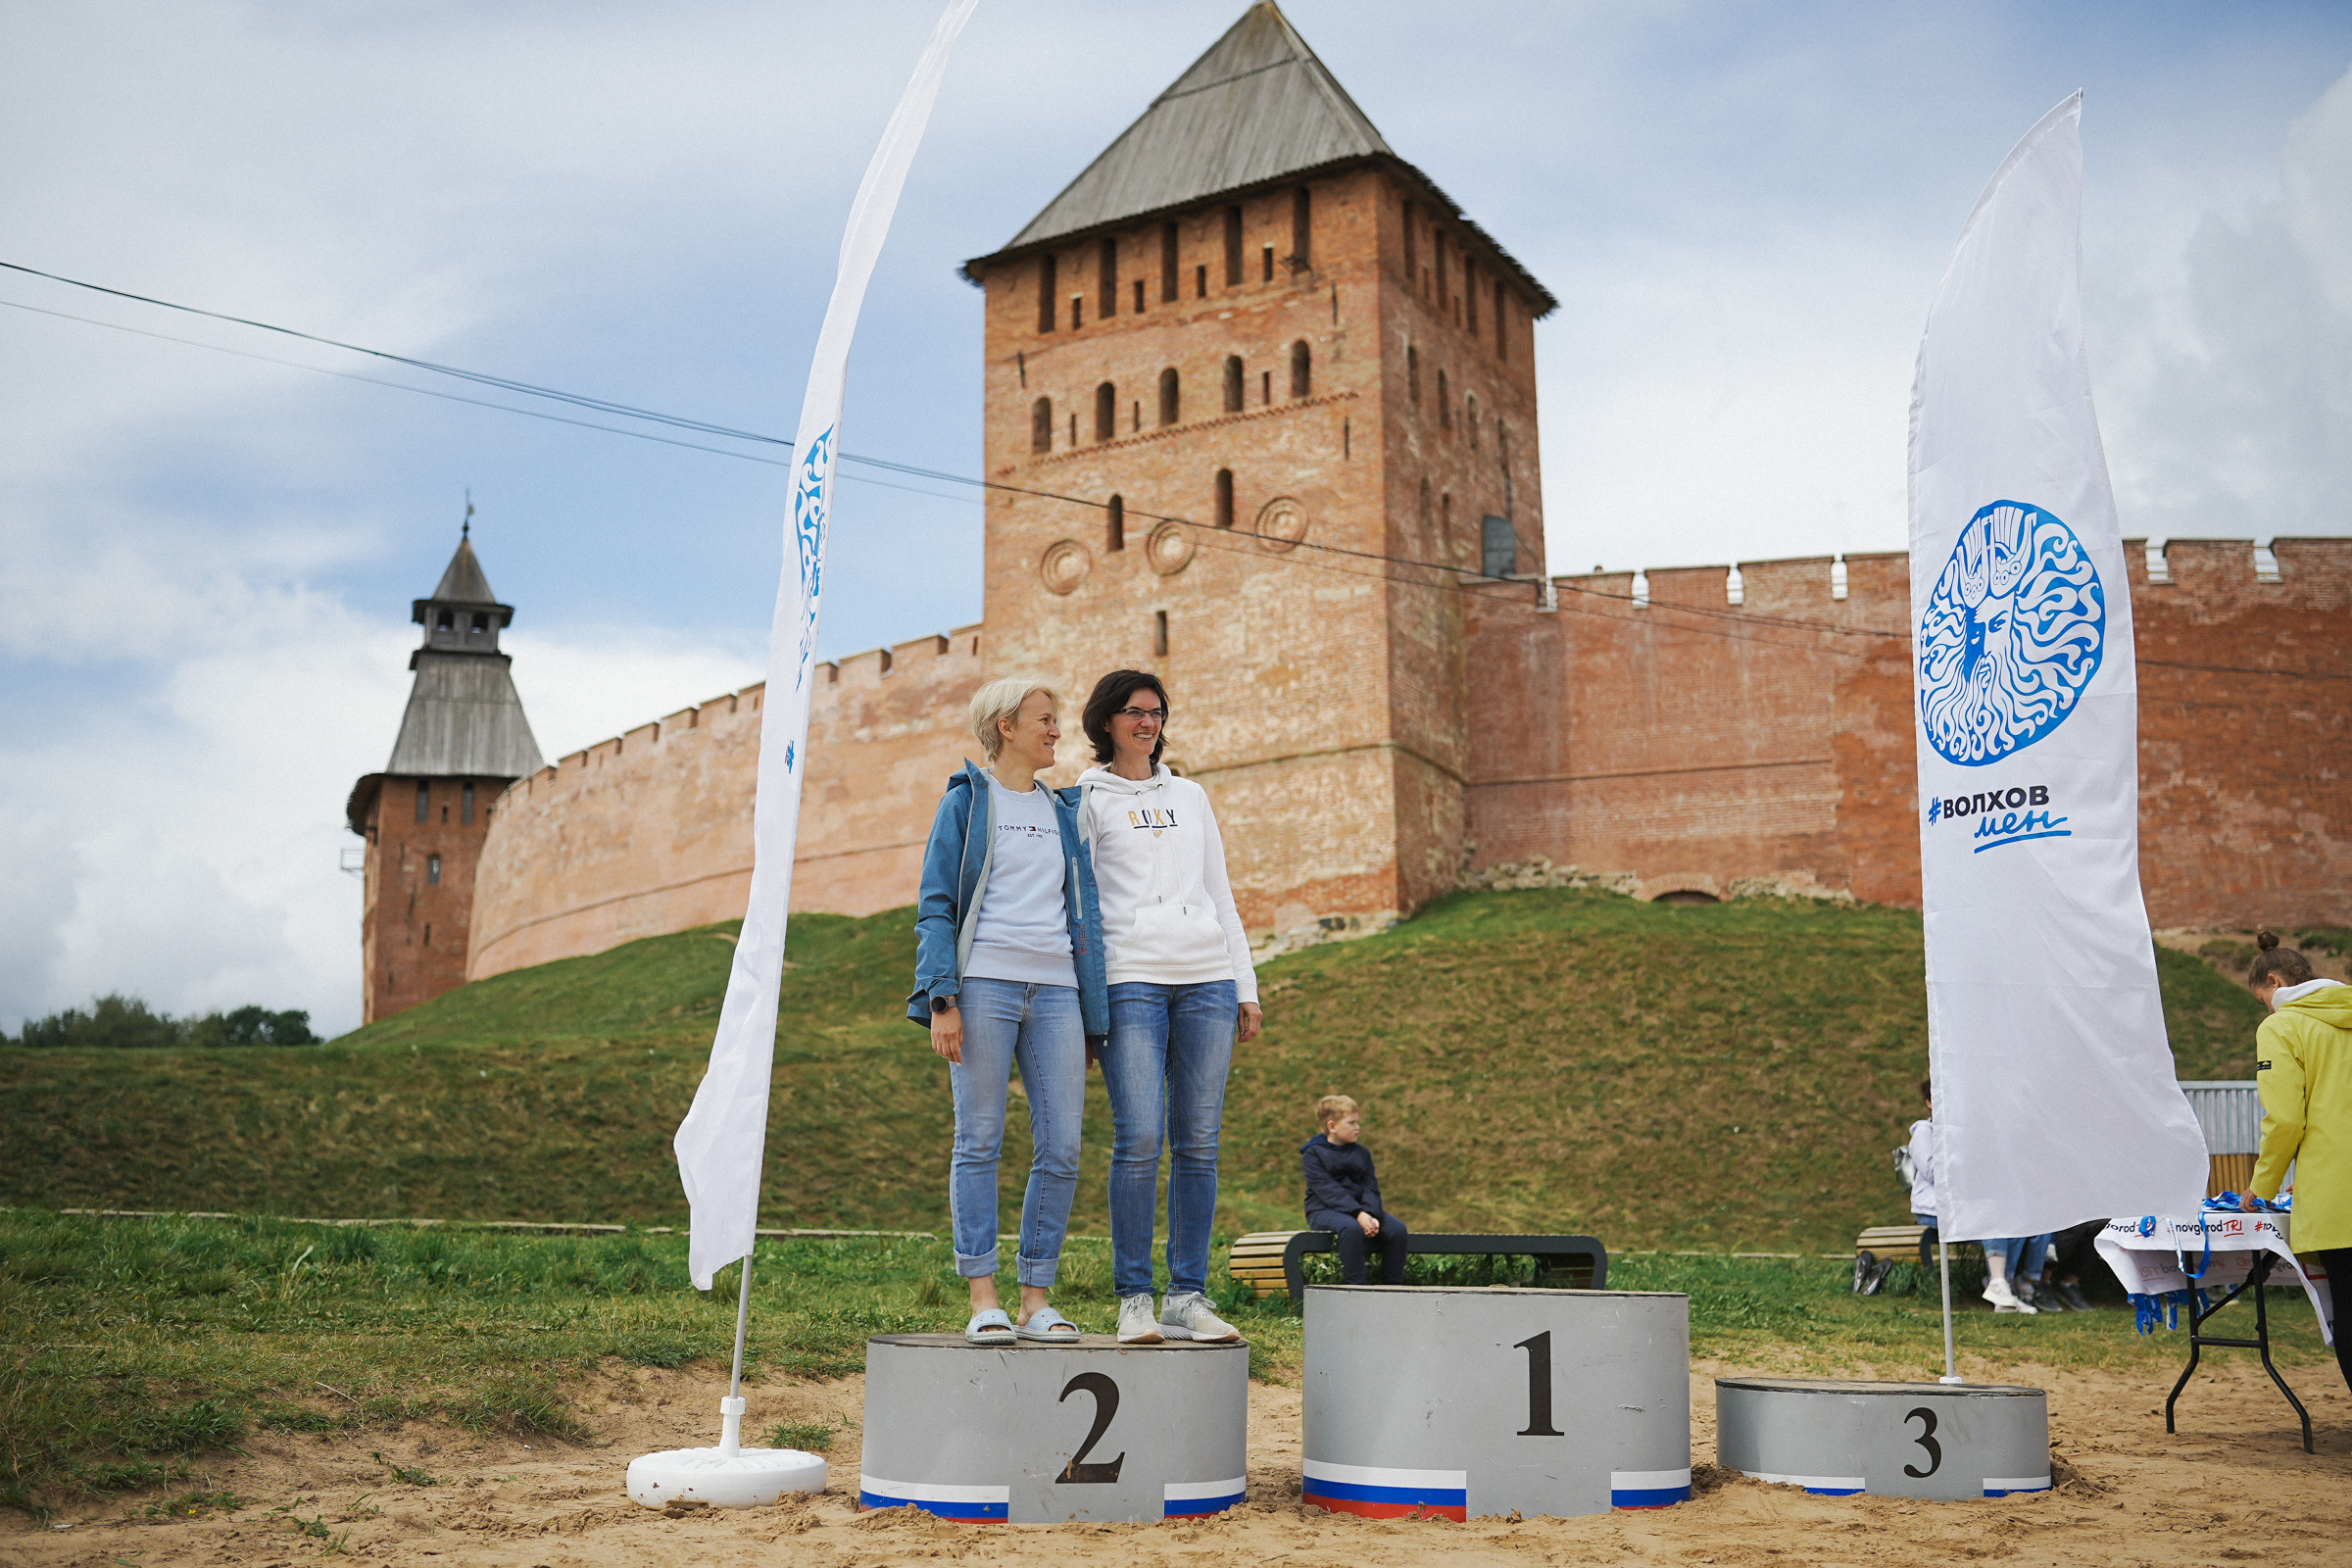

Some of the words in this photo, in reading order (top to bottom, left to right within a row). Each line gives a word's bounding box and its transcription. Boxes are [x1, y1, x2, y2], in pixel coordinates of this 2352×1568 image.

[1128, 808, 1176, 826] ROXY
[1928, 785, 2050, 826] #ВОЛХОВ
[1974, 809, 2068, 839] мен
[1037, 827, 1061, 836] HILFIG
[1513, 1330, 1565, 1437] 1
[1054, 1371, 1126, 1485] 2
[1903, 1406, 1942, 1479] 3
